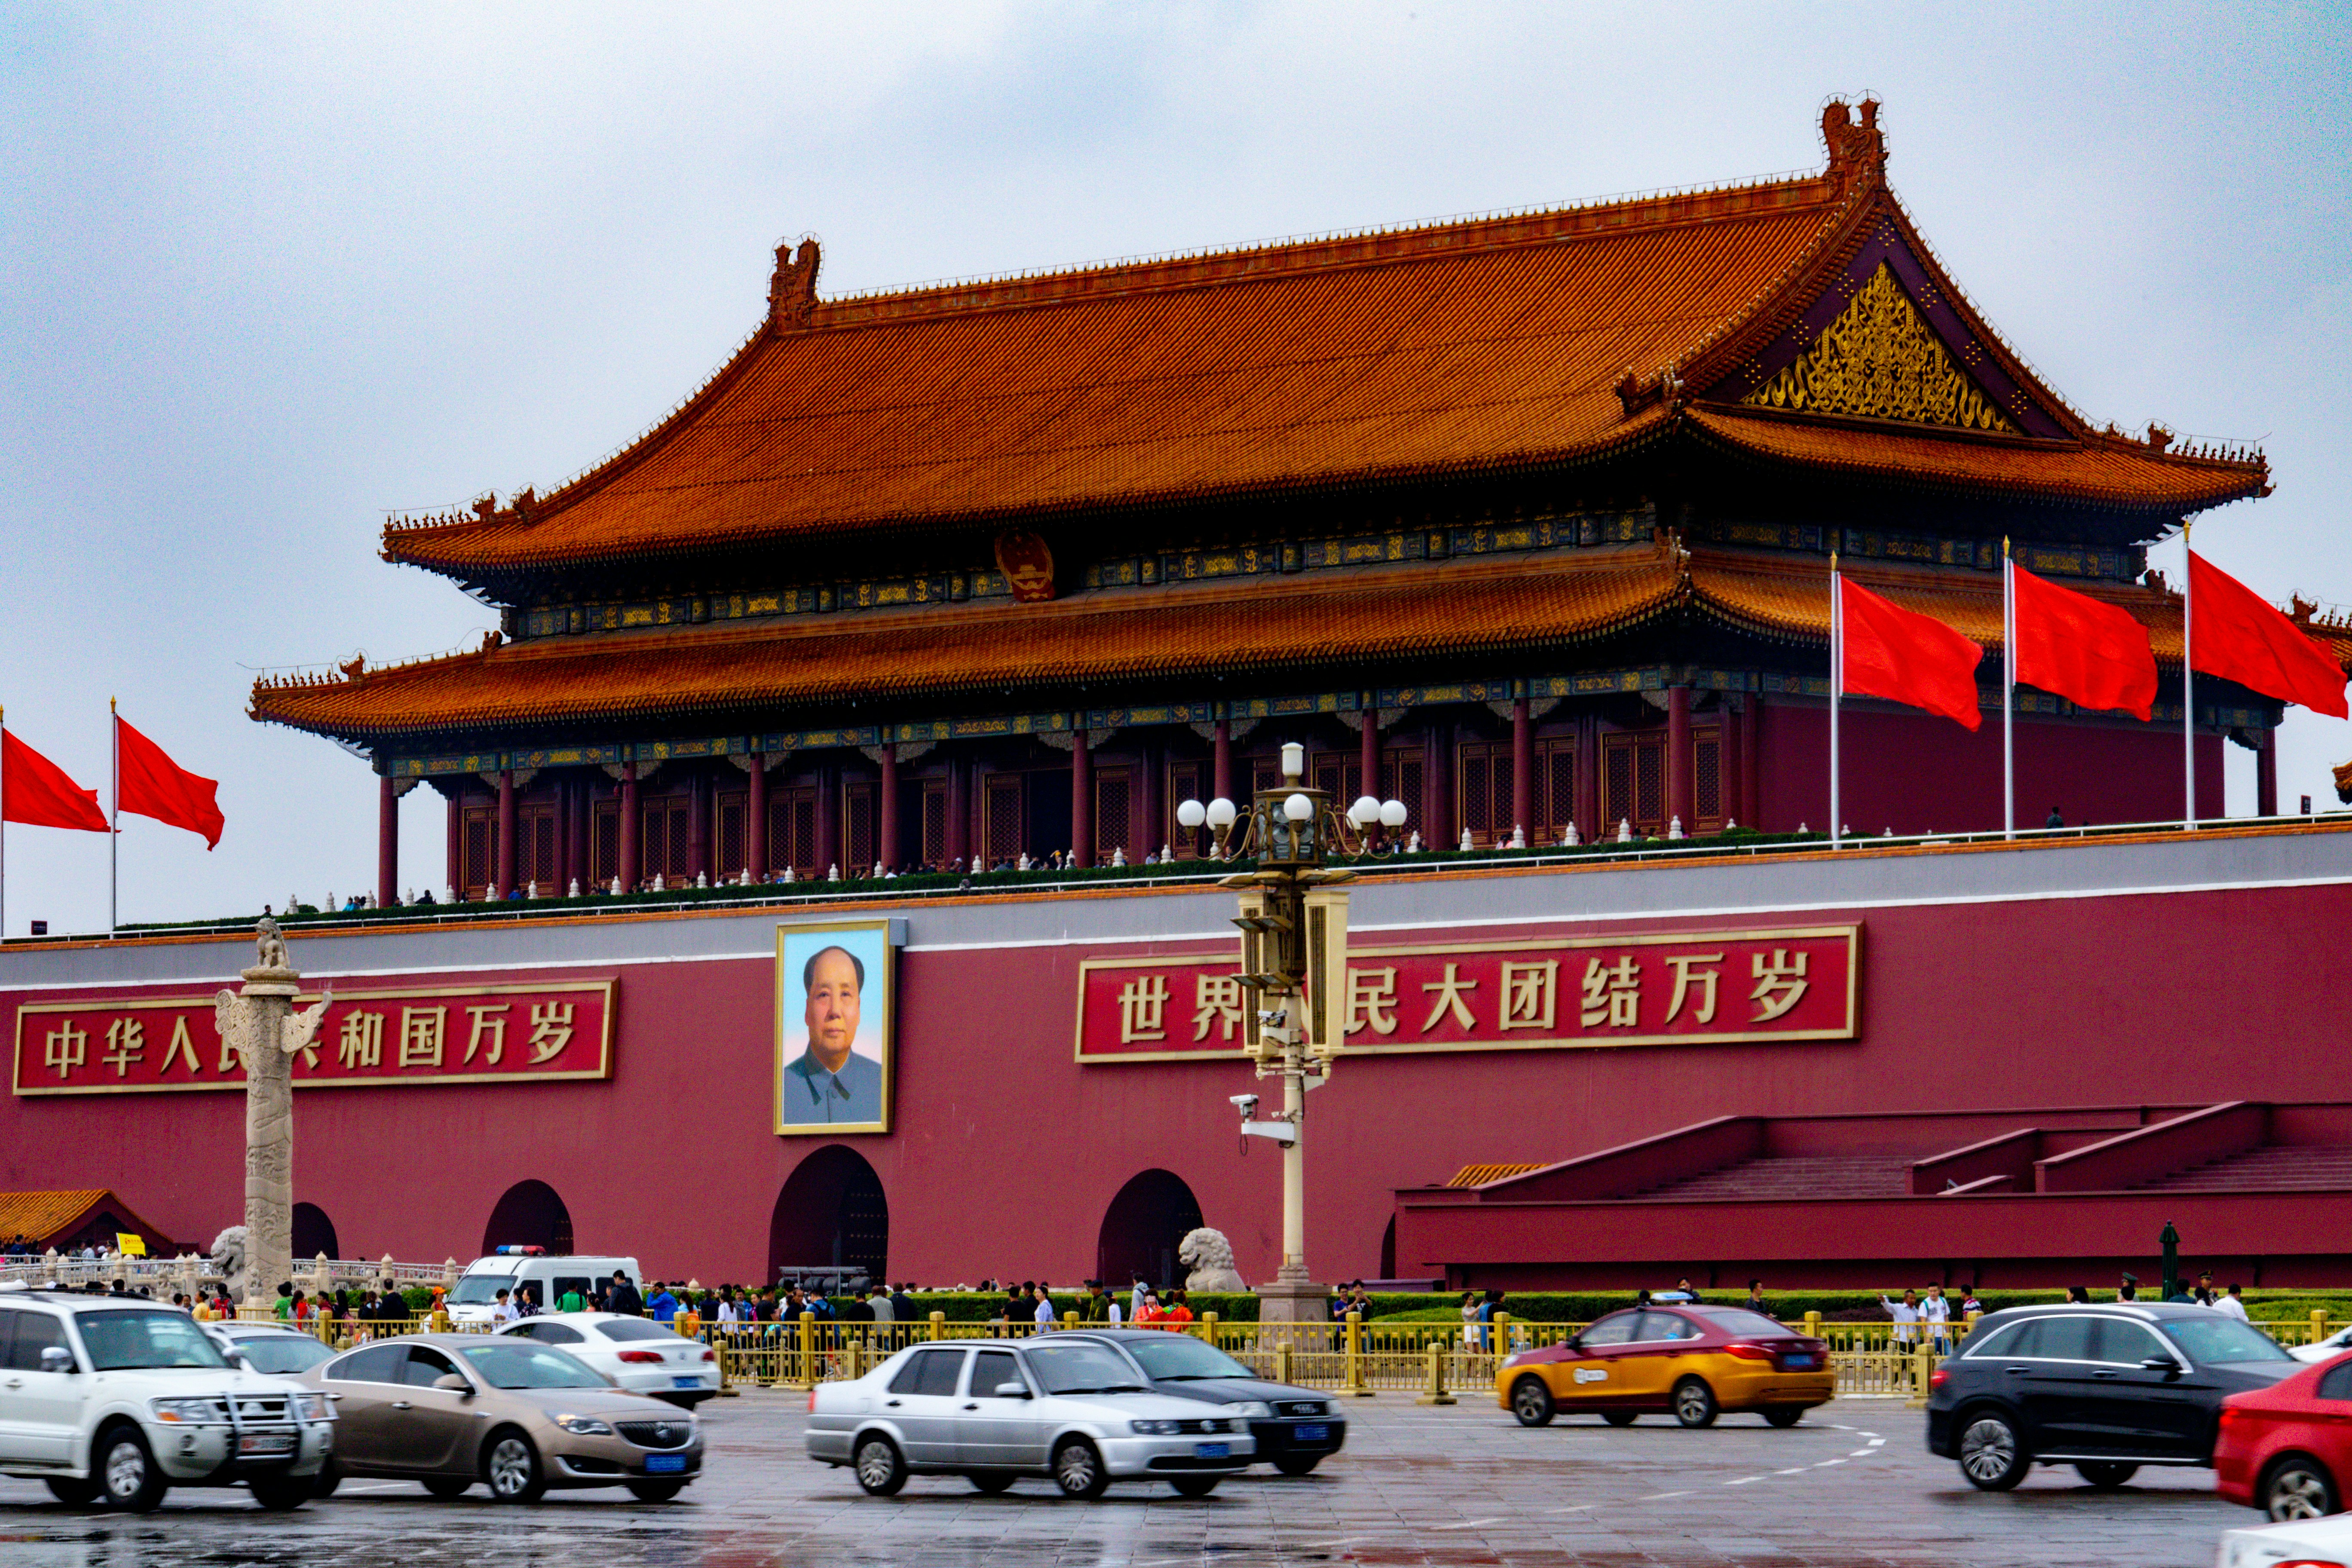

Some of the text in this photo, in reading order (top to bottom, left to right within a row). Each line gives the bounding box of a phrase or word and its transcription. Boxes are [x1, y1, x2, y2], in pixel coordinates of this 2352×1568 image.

[44, 1001, 576, 1078] 中华人和国万岁
[1117, 949, 1808, 1044] 世界民大团结万岁
